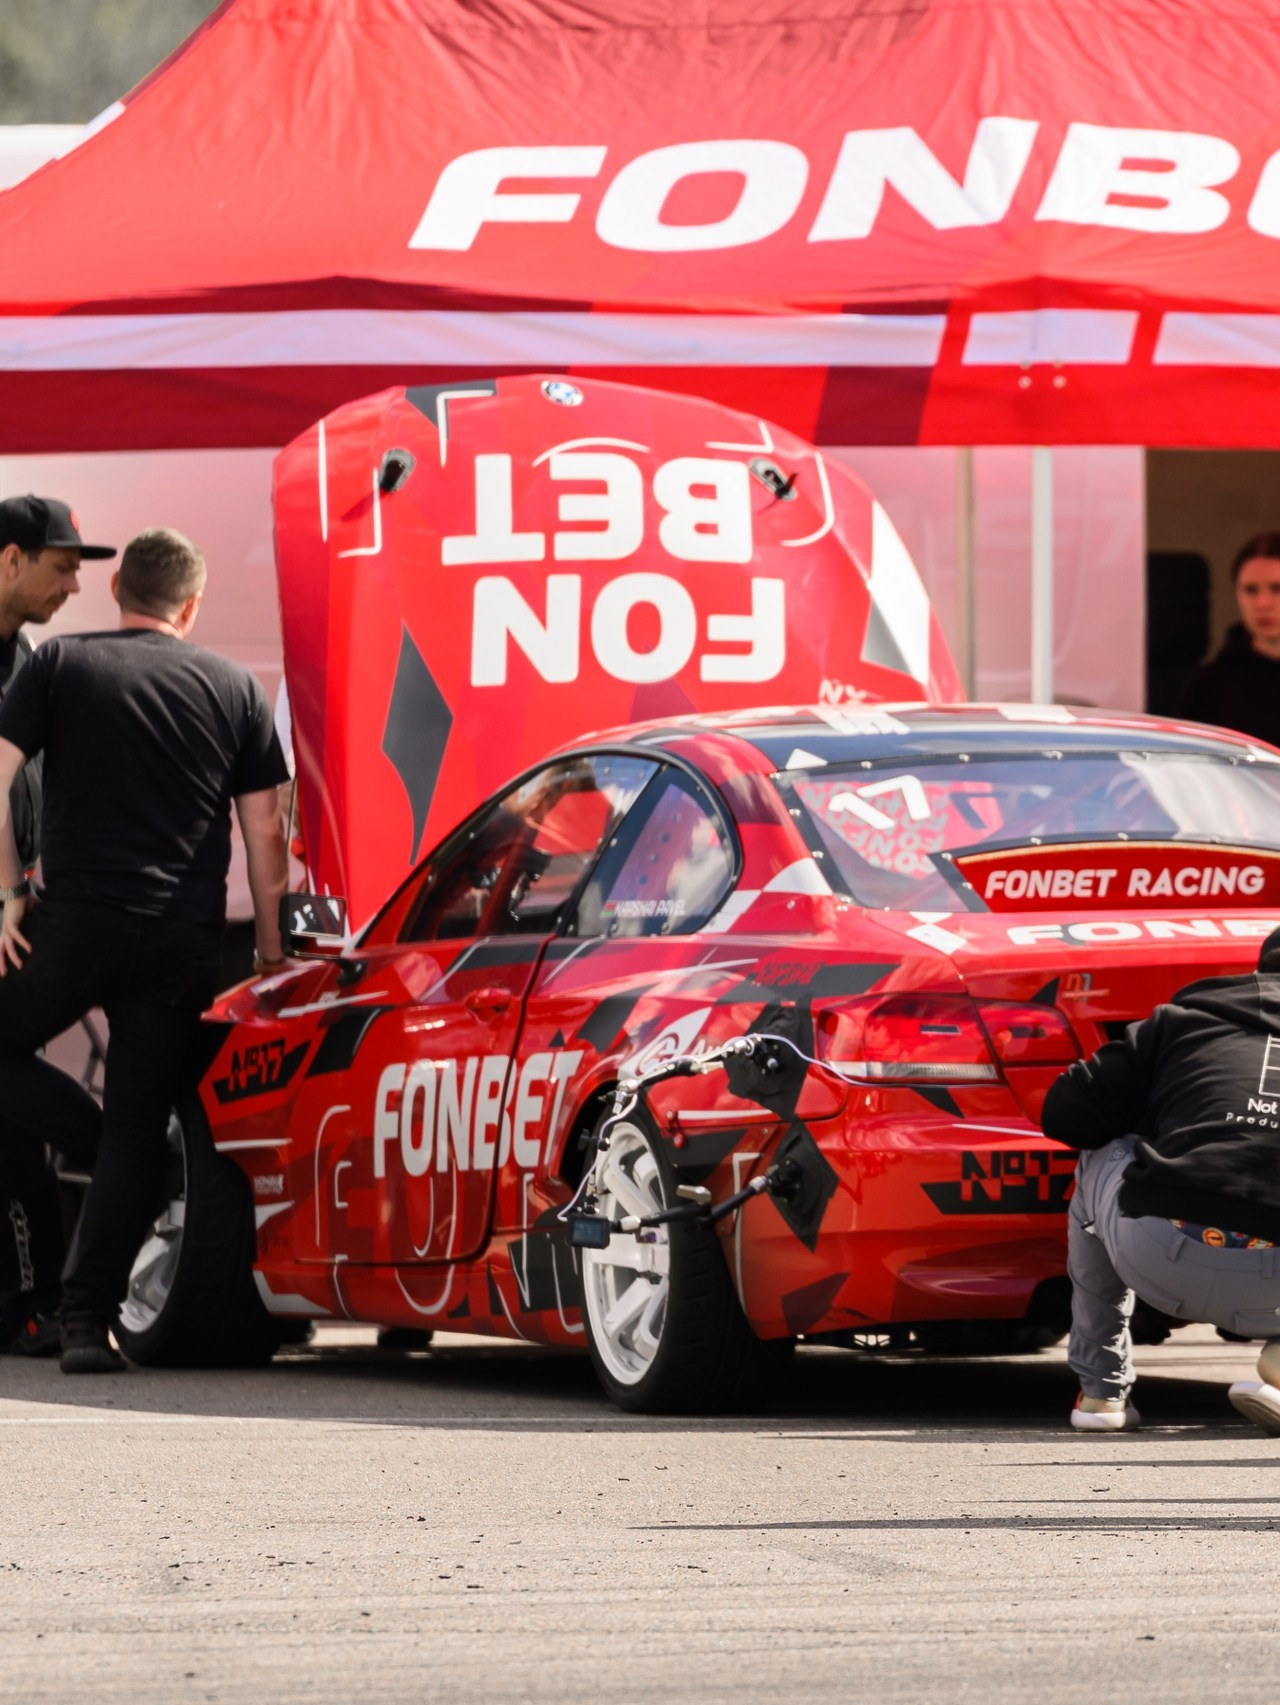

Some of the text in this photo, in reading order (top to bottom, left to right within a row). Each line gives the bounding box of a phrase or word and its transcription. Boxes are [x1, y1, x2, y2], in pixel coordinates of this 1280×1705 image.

[441, 452, 752, 566] BET
[471, 572, 786, 687] FON
[828, 774, 931, 830] 17
[985, 865, 1265, 899] FONBET RACING
[373, 1050, 584, 1178] FONBET
[1247, 1098, 1278, 1115] Not
